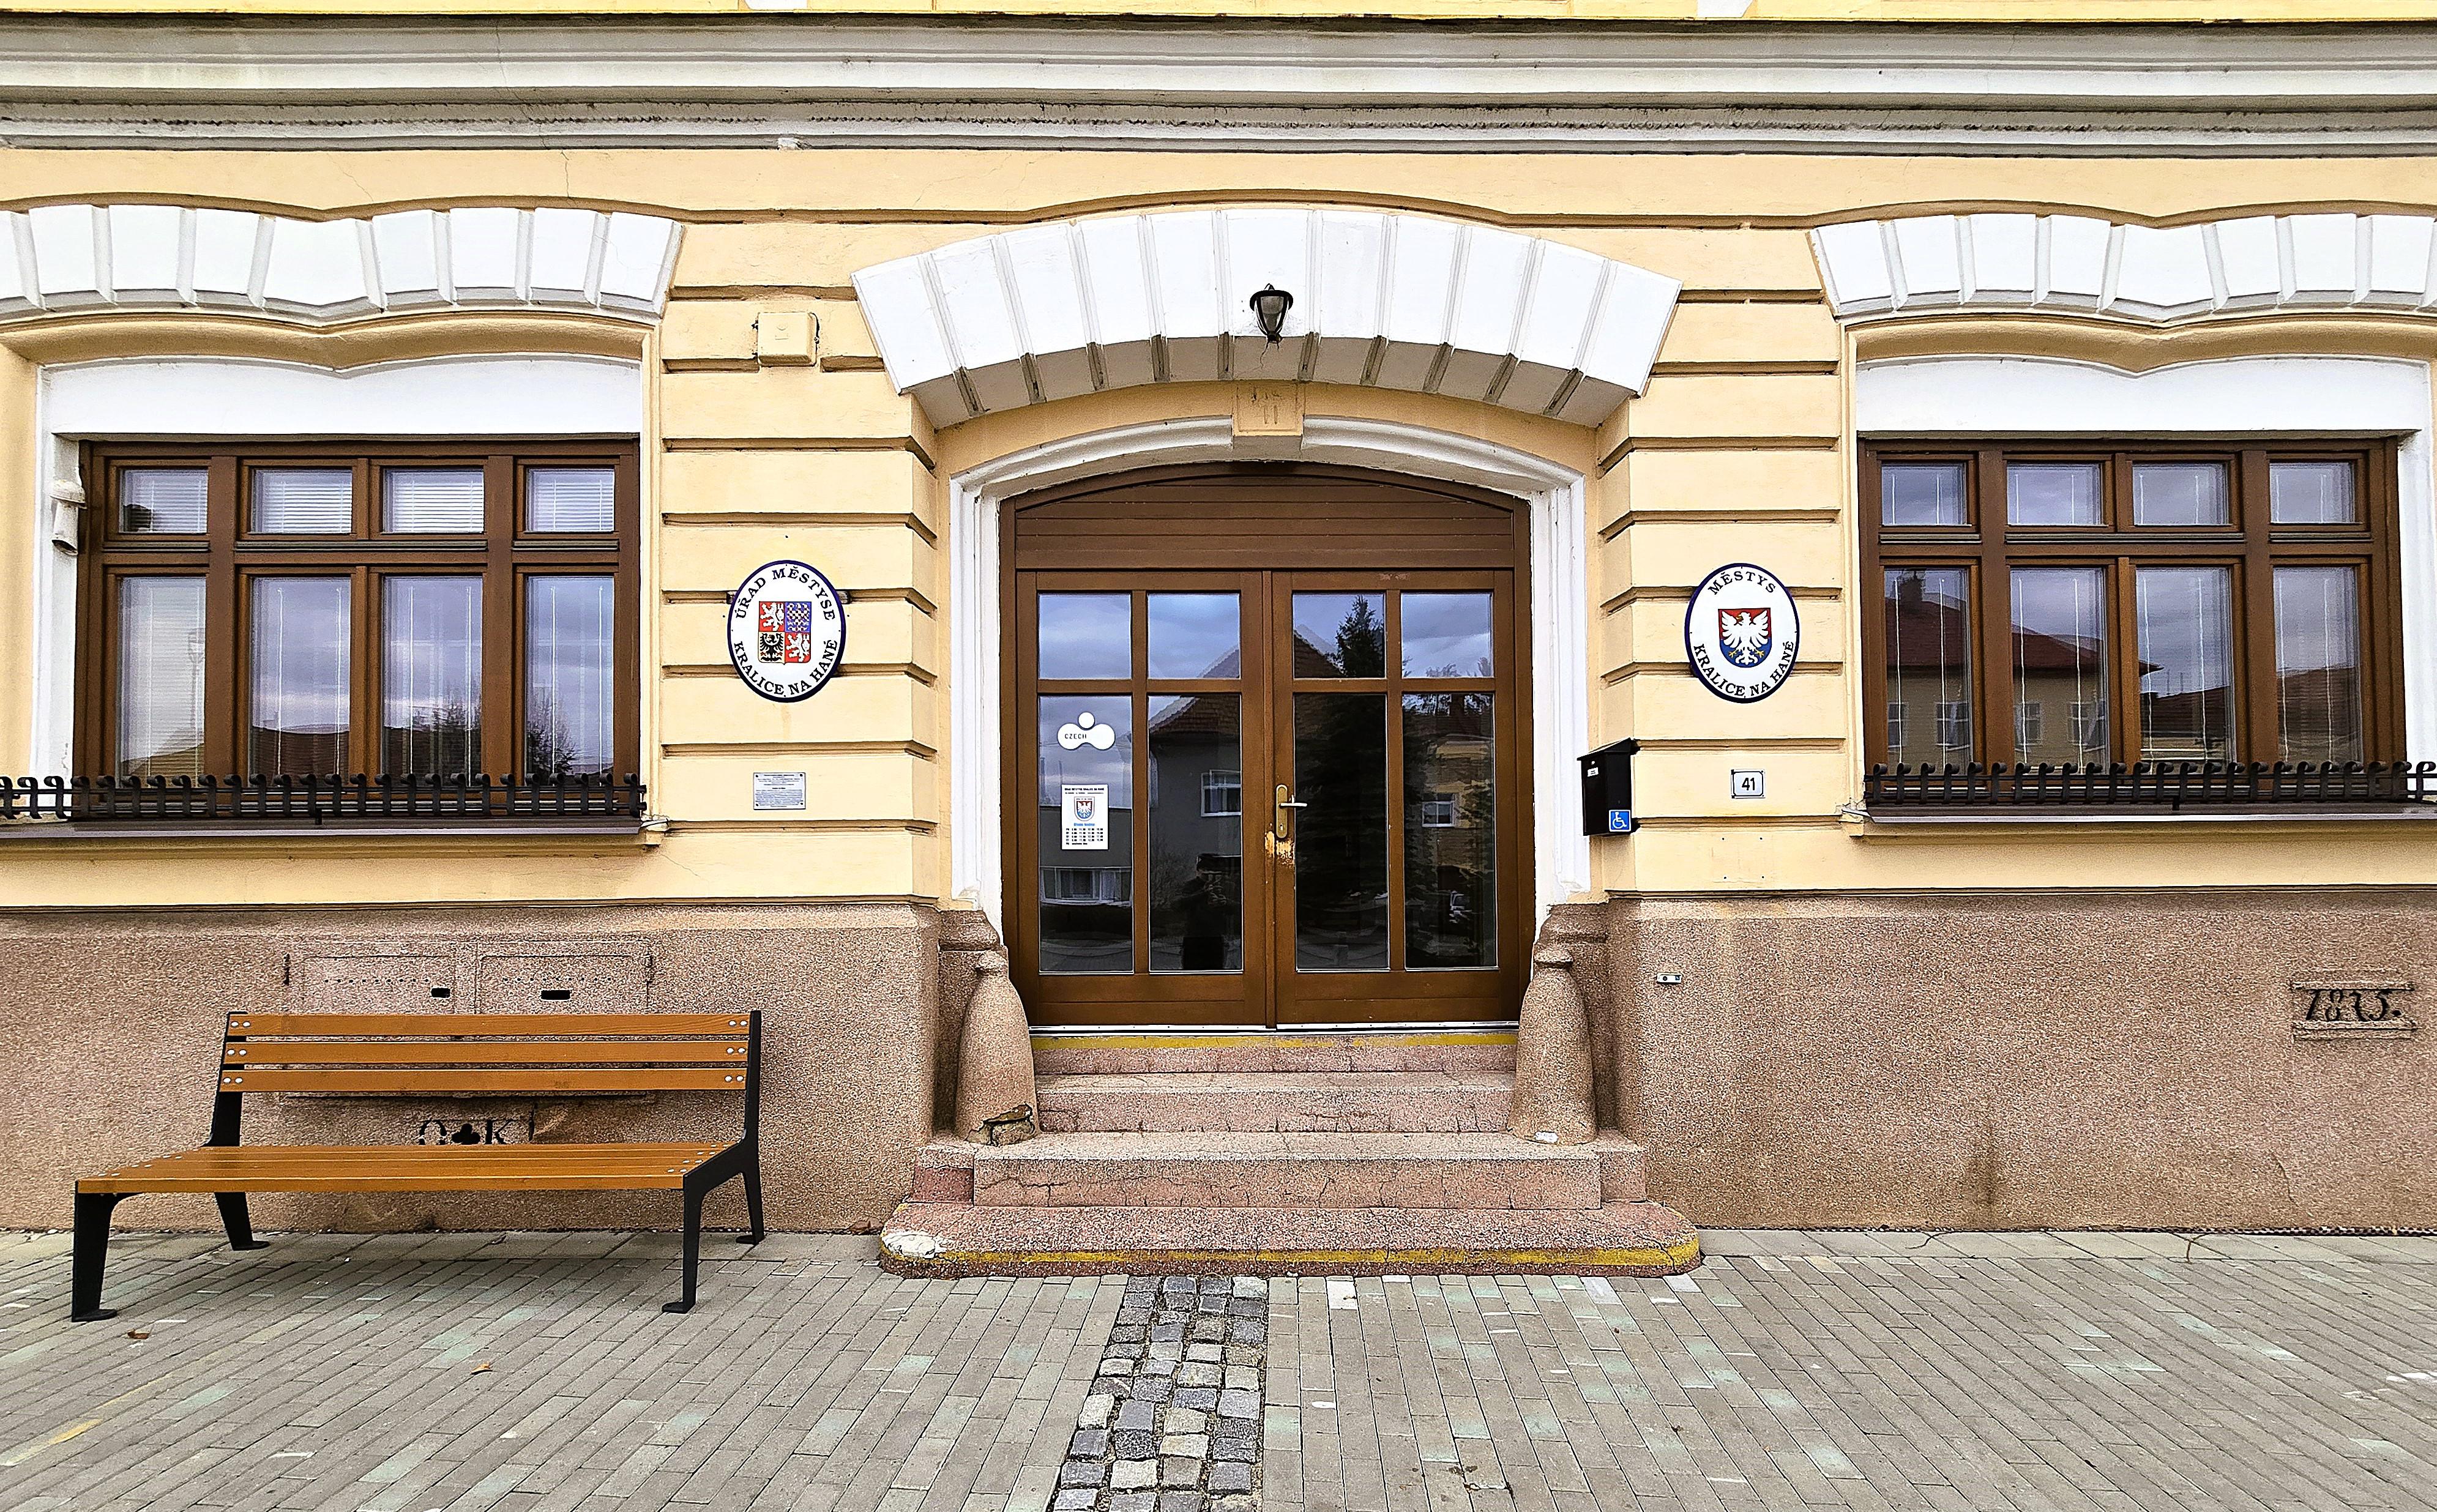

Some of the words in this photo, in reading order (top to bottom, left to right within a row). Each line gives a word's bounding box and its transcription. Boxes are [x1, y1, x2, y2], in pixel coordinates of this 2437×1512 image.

[736, 577, 766, 619] ÚŘAD
[772, 566, 835, 620] MĚSTYSE
[1707, 571, 1776, 595] MĚSTYS
[734, 641, 784, 695] KRALICE
[788, 680, 812, 696] NA
[809, 639, 838, 682] HANÉ
[1693, 643, 1745, 696] KRALICE
[1749, 681, 1771, 696] NA
[1770, 641, 1794, 683] HANÉ
[1741, 777, 1755, 791] 41
